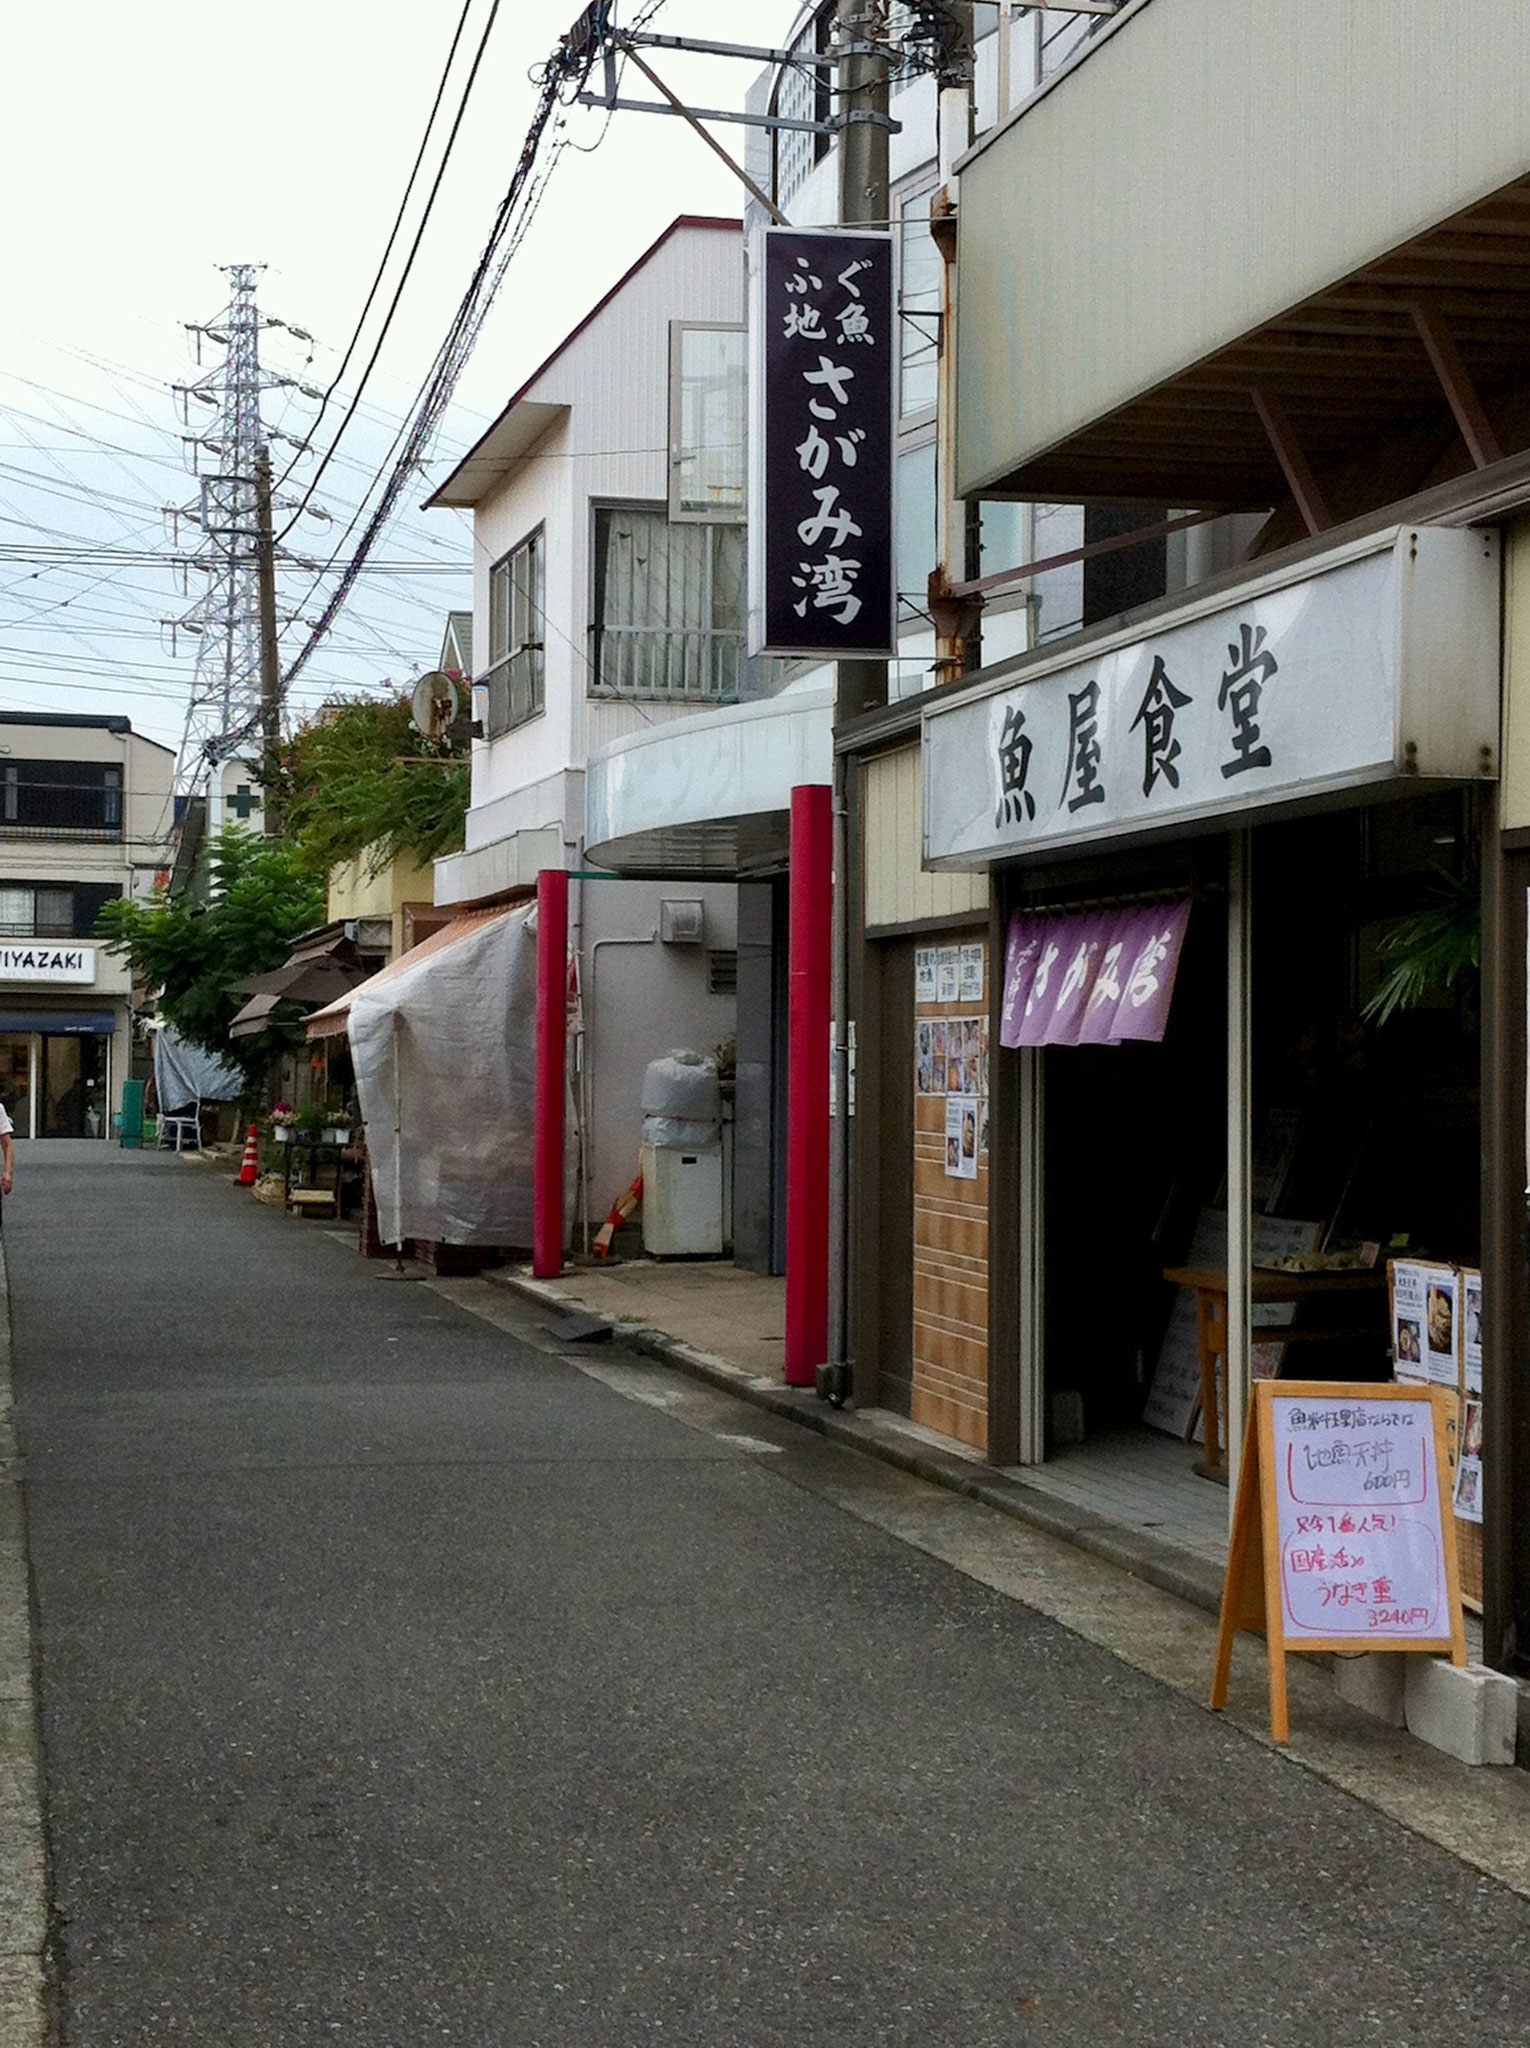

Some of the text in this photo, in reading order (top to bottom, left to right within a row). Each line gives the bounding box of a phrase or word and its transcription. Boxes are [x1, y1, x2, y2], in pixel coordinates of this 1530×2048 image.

[784, 256, 874, 298] ふぐ
[782, 302, 876, 346] 地魚
[791, 355, 868, 626] さがみ湾
[995, 623, 1279, 829] 魚屋食堂
[0, 950, 83, 969] IYAZAKI
[1363, 1469, 1411, 1491] 600円
[1317, 1575, 1397, 1607] うなぎ重
[1367, 1607, 1429, 1627] 3240円
